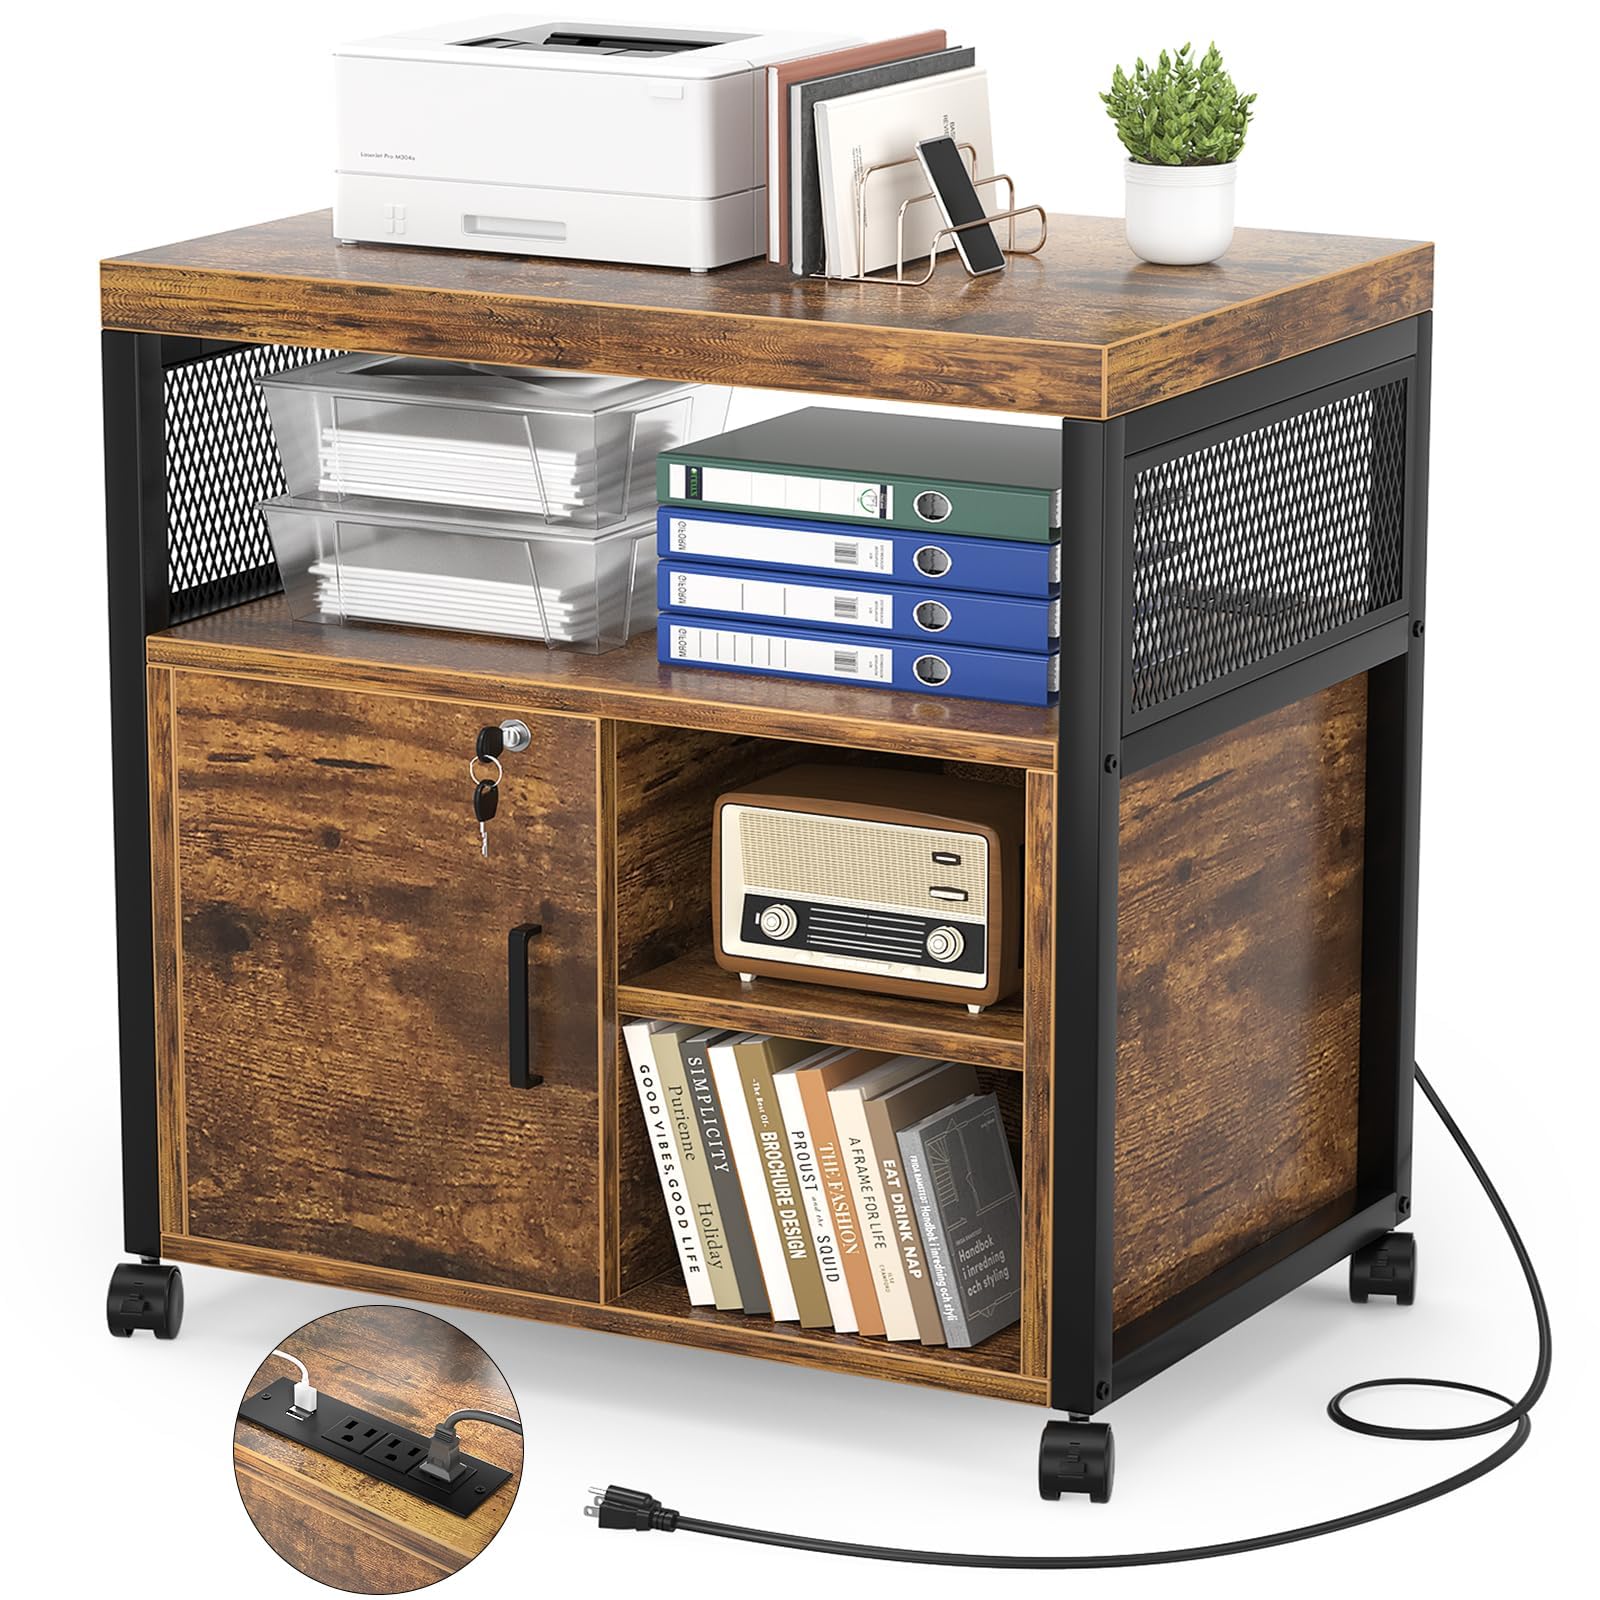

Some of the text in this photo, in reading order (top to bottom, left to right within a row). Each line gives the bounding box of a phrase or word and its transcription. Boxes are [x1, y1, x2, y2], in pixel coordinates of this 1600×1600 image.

[640, 1064, 660, 1115] GOOD
[668, 1179, 689, 1228] GOOD
[682, 1237, 700, 1273] LIFE
[687, 1057, 730, 1173] SIMPLICITY
[668, 1085, 723, 1269] Purienne Holiday
[759, 1131, 807, 1259] BROCHURE DESIGN
[791, 1131, 818, 1191] PROUST
[817, 1235, 840, 1282] SQUID
[818, 1142, 860, 1255] THE FASHION
[848, 1137, 887, 1249] A FRAME FOR LIFE
[882, 1160, 922, 1279] EAT DRINK NAP
[921, 1205, 939, 1242] Handbok
[930, 1248, 947, 1287] inredning
[940, 1287, 953, 1303] och
[958, 1234, 995, 1263] Handbok
[961, 1250, 1006, 1280] i inredning
[967, 1267, 1010, 1297] och styling
